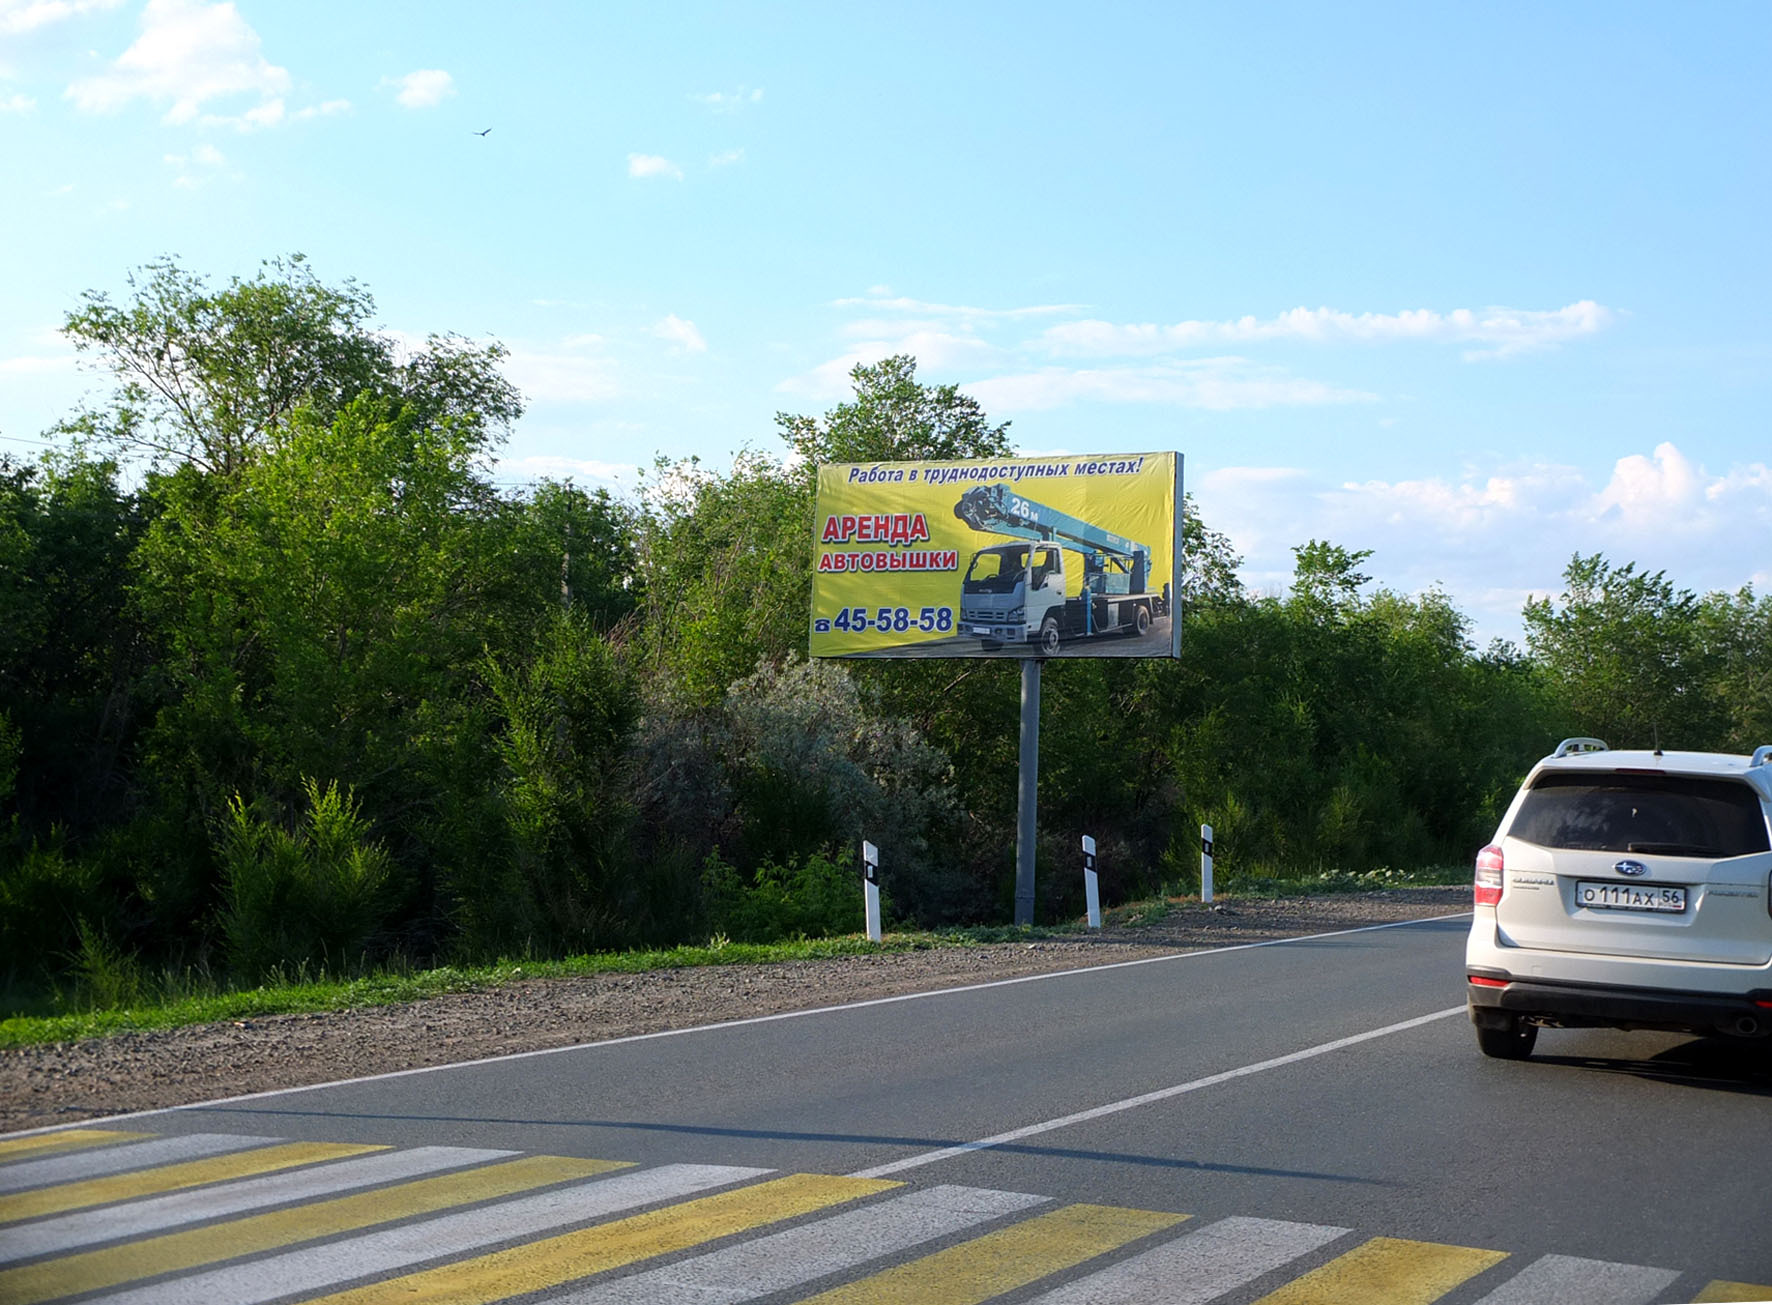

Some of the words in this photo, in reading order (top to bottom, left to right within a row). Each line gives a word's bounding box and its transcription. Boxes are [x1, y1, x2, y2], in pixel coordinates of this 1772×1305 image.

[848, 465, 904, 483] Работа
[909, 469, 918, 481] в
[923, 463, 1070, 485] труднодоступных
[1074, 457, 1144, 476] местах!
[1010, 497, 1029, 518] 26
[822, 514, 928, 544] АРЕНДА
[819, 551, 957, 571] АВТОВЫШКИ
[834, 607, 953, 633] 45-58-58
